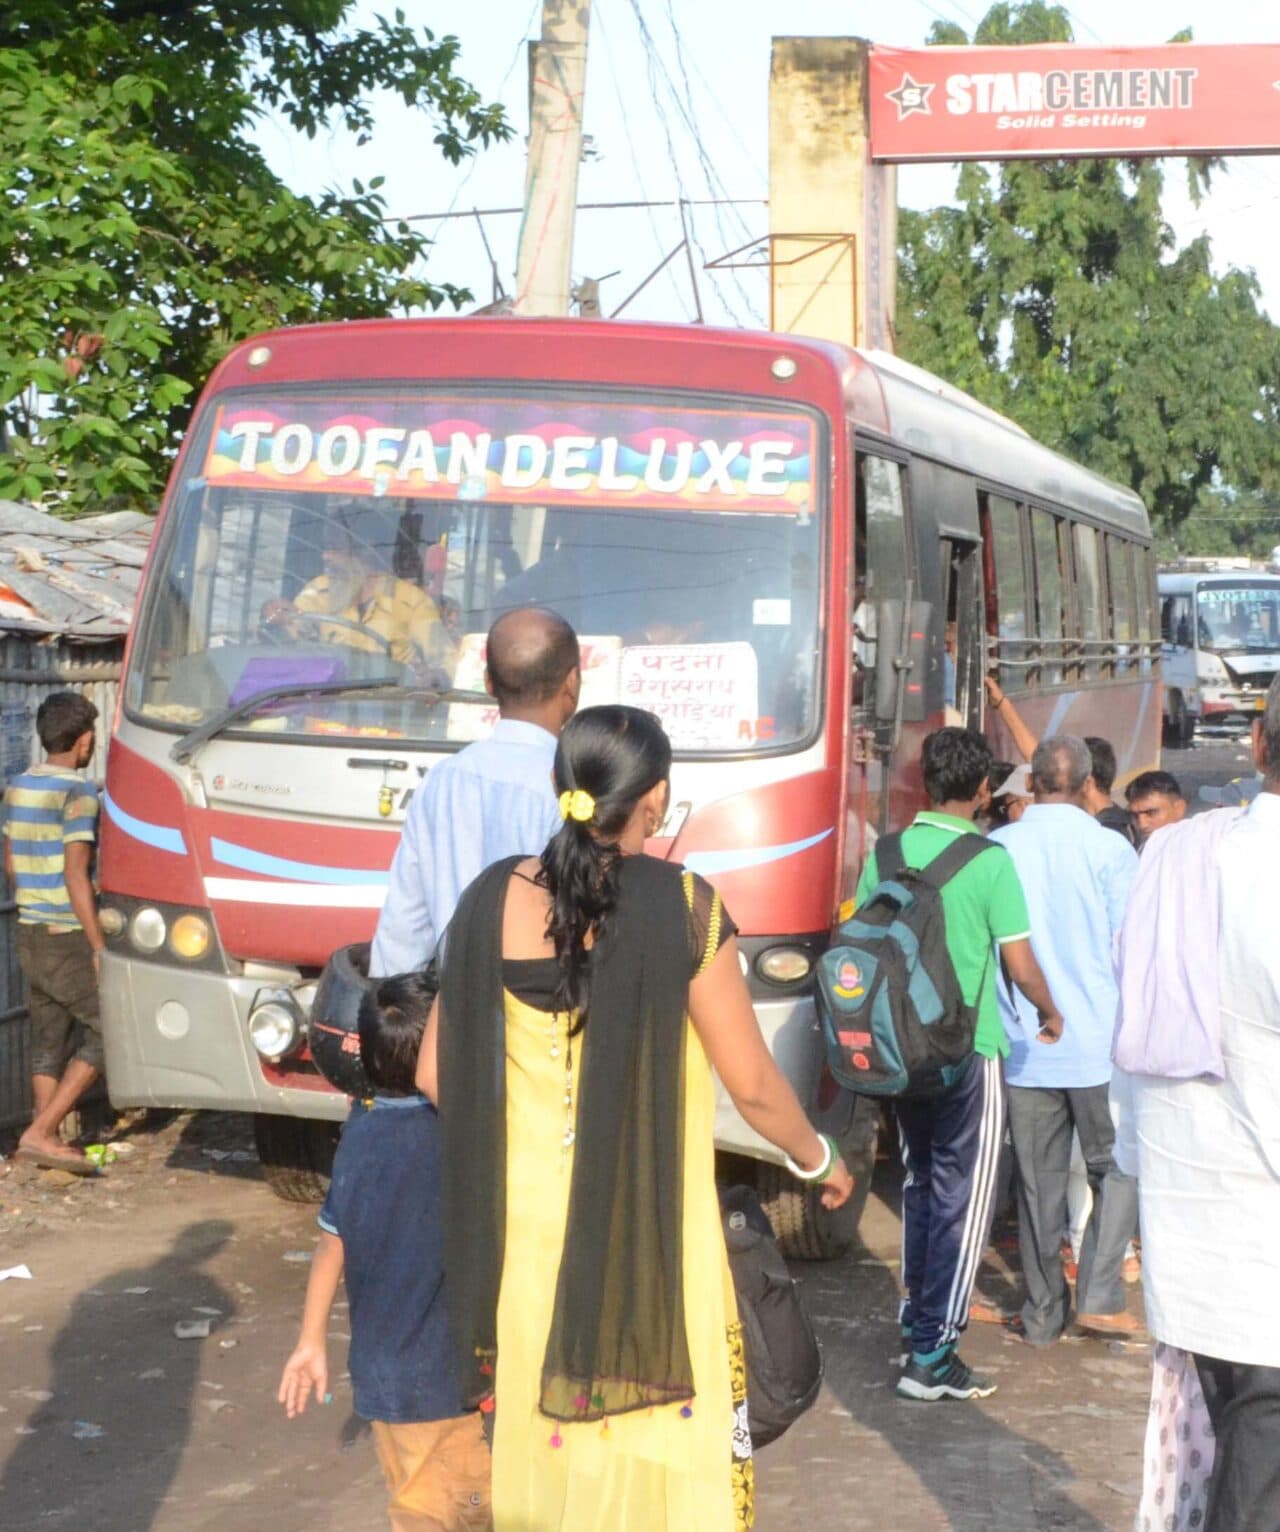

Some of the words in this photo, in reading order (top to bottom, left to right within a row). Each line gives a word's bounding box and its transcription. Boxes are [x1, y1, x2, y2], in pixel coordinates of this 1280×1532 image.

[996, 114, 1054, 130] Solid
[1061, 113, 1147, 129] Setting
[231, 420, 491, 485] TOOFAN
[500, 434, 795, 496] DELUXE
[642, 653, 725, 673] पटना
[737, 715, 775, 741] AC
